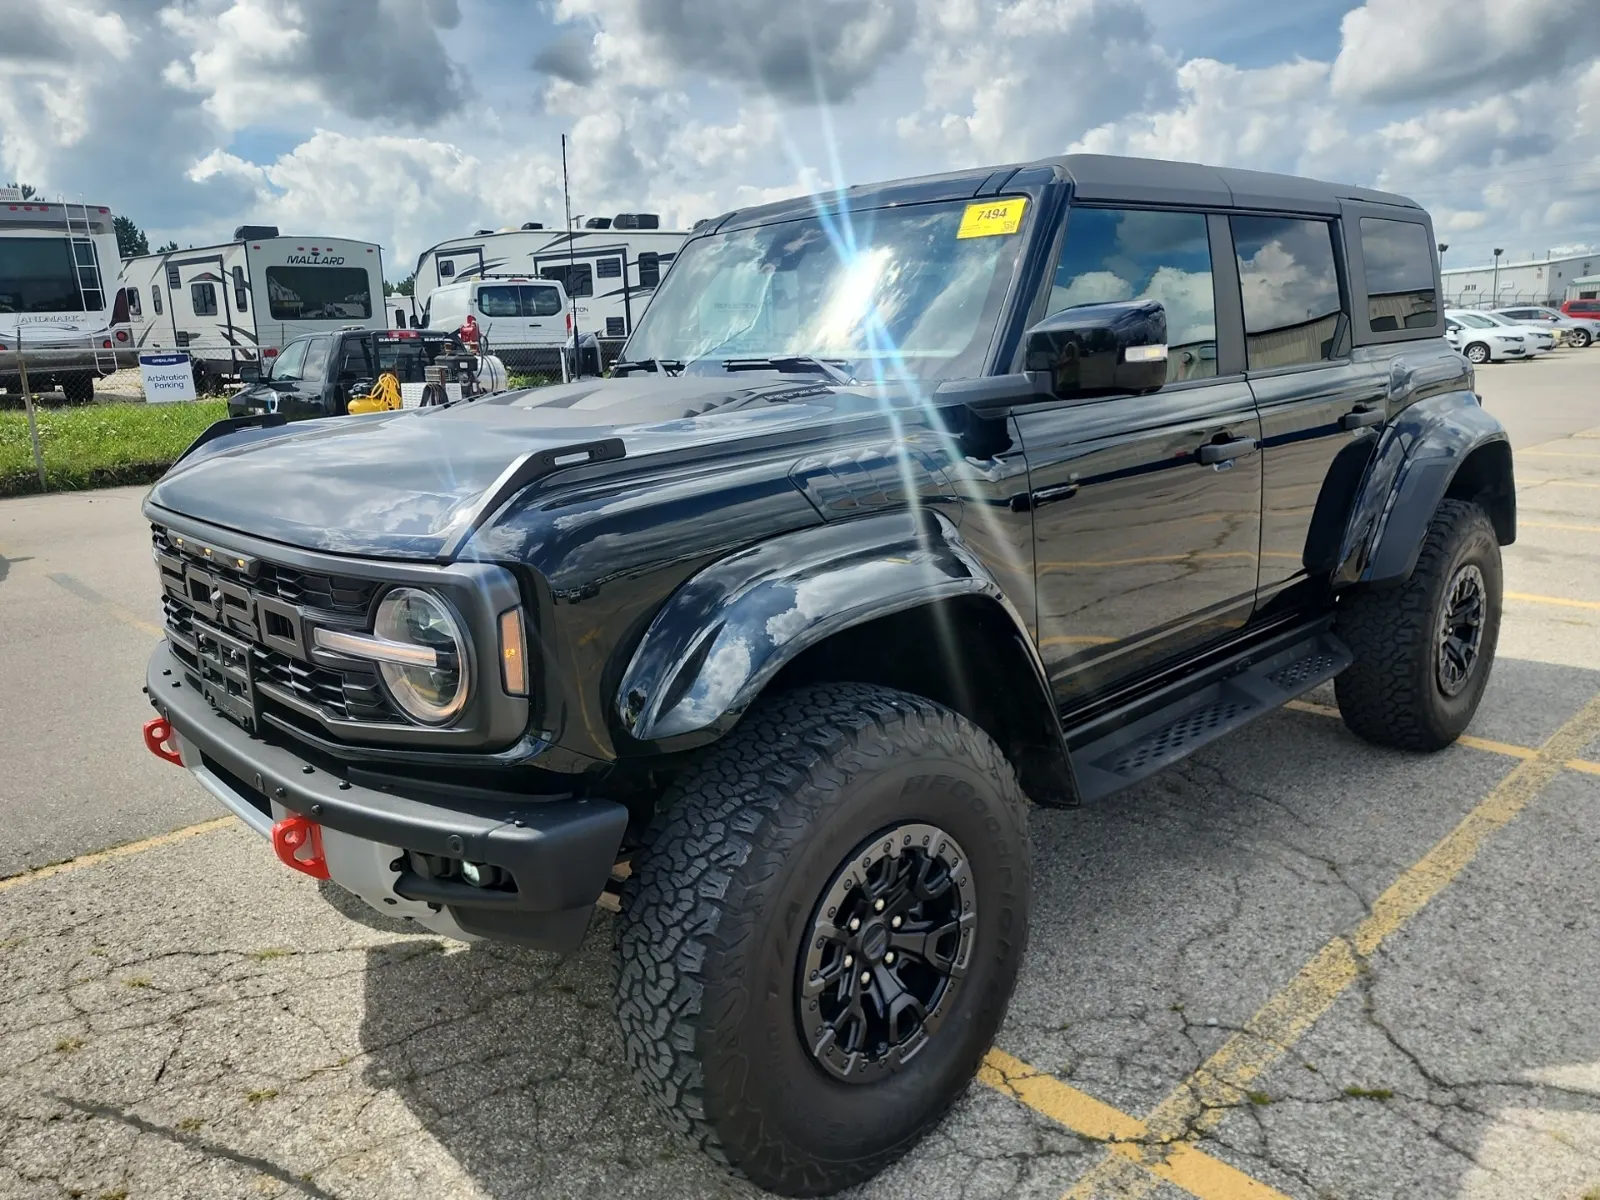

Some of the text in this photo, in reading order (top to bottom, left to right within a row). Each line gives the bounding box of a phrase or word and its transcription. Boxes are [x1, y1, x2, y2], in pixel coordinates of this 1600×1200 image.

[977, 208, 1007, 221] 7494
[286, 255, 345, 265] MALLARD
[147, 373, 189, 382] Arbitration
[154, 381, 184, 390] Parking
[156, 552, 306, 661] FORD
